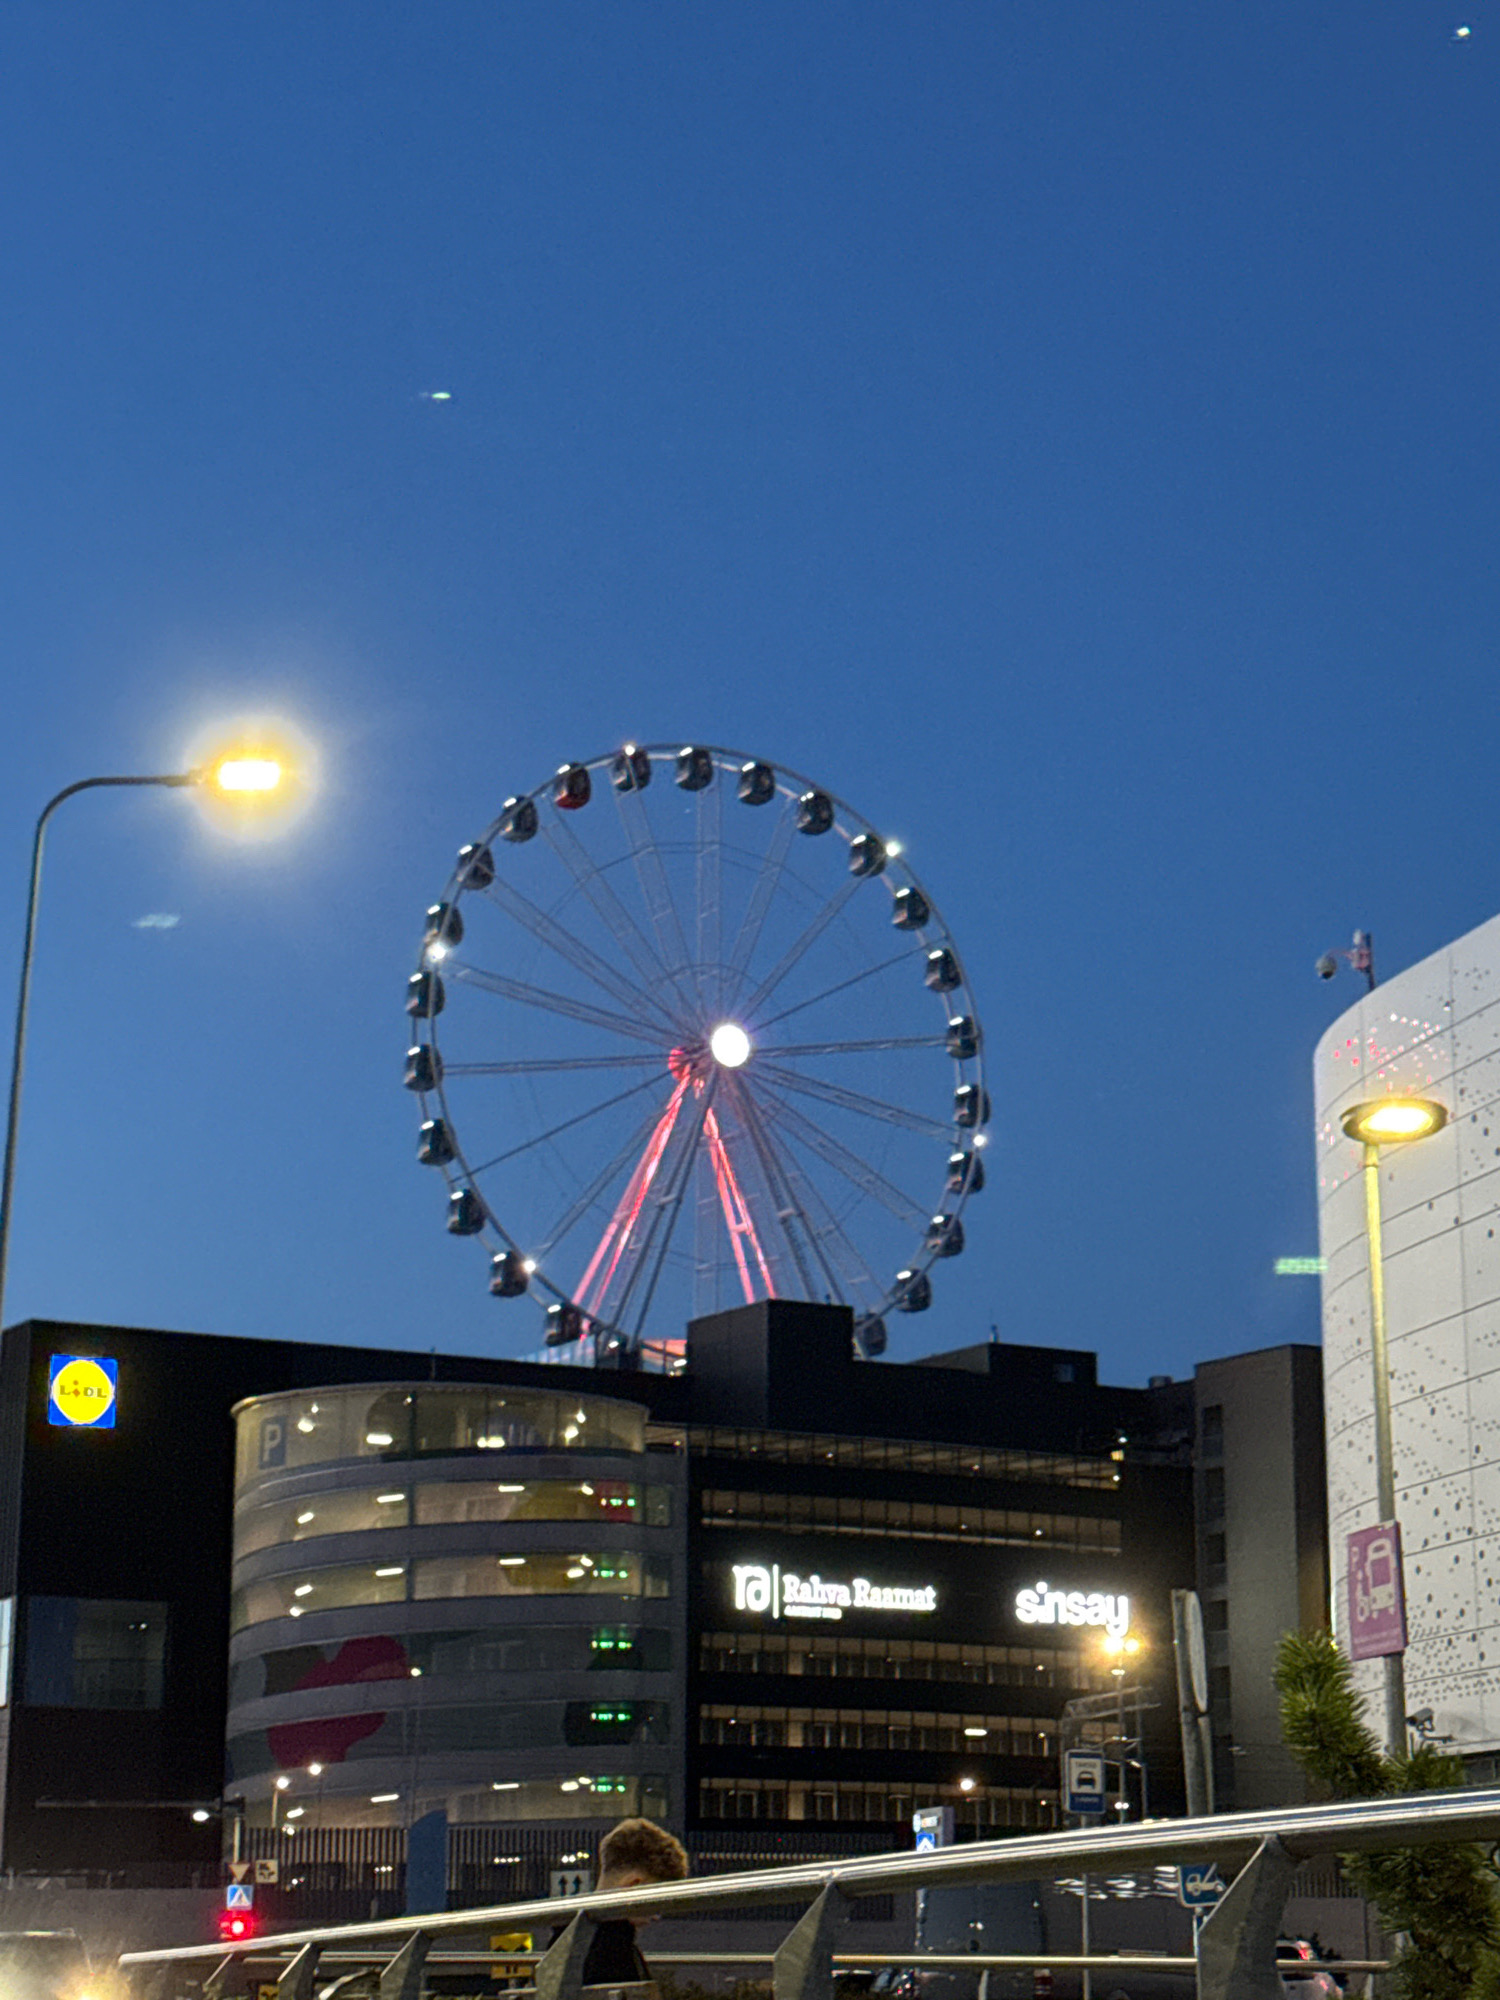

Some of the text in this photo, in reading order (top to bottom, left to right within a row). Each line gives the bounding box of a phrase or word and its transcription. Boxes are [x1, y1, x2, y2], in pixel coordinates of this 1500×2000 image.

[263, 1424, 282, 1462] P
[782, 1574, 936, 1611] Rahva Raamat
[1015, 1581, 1129, 1640] sinsay
